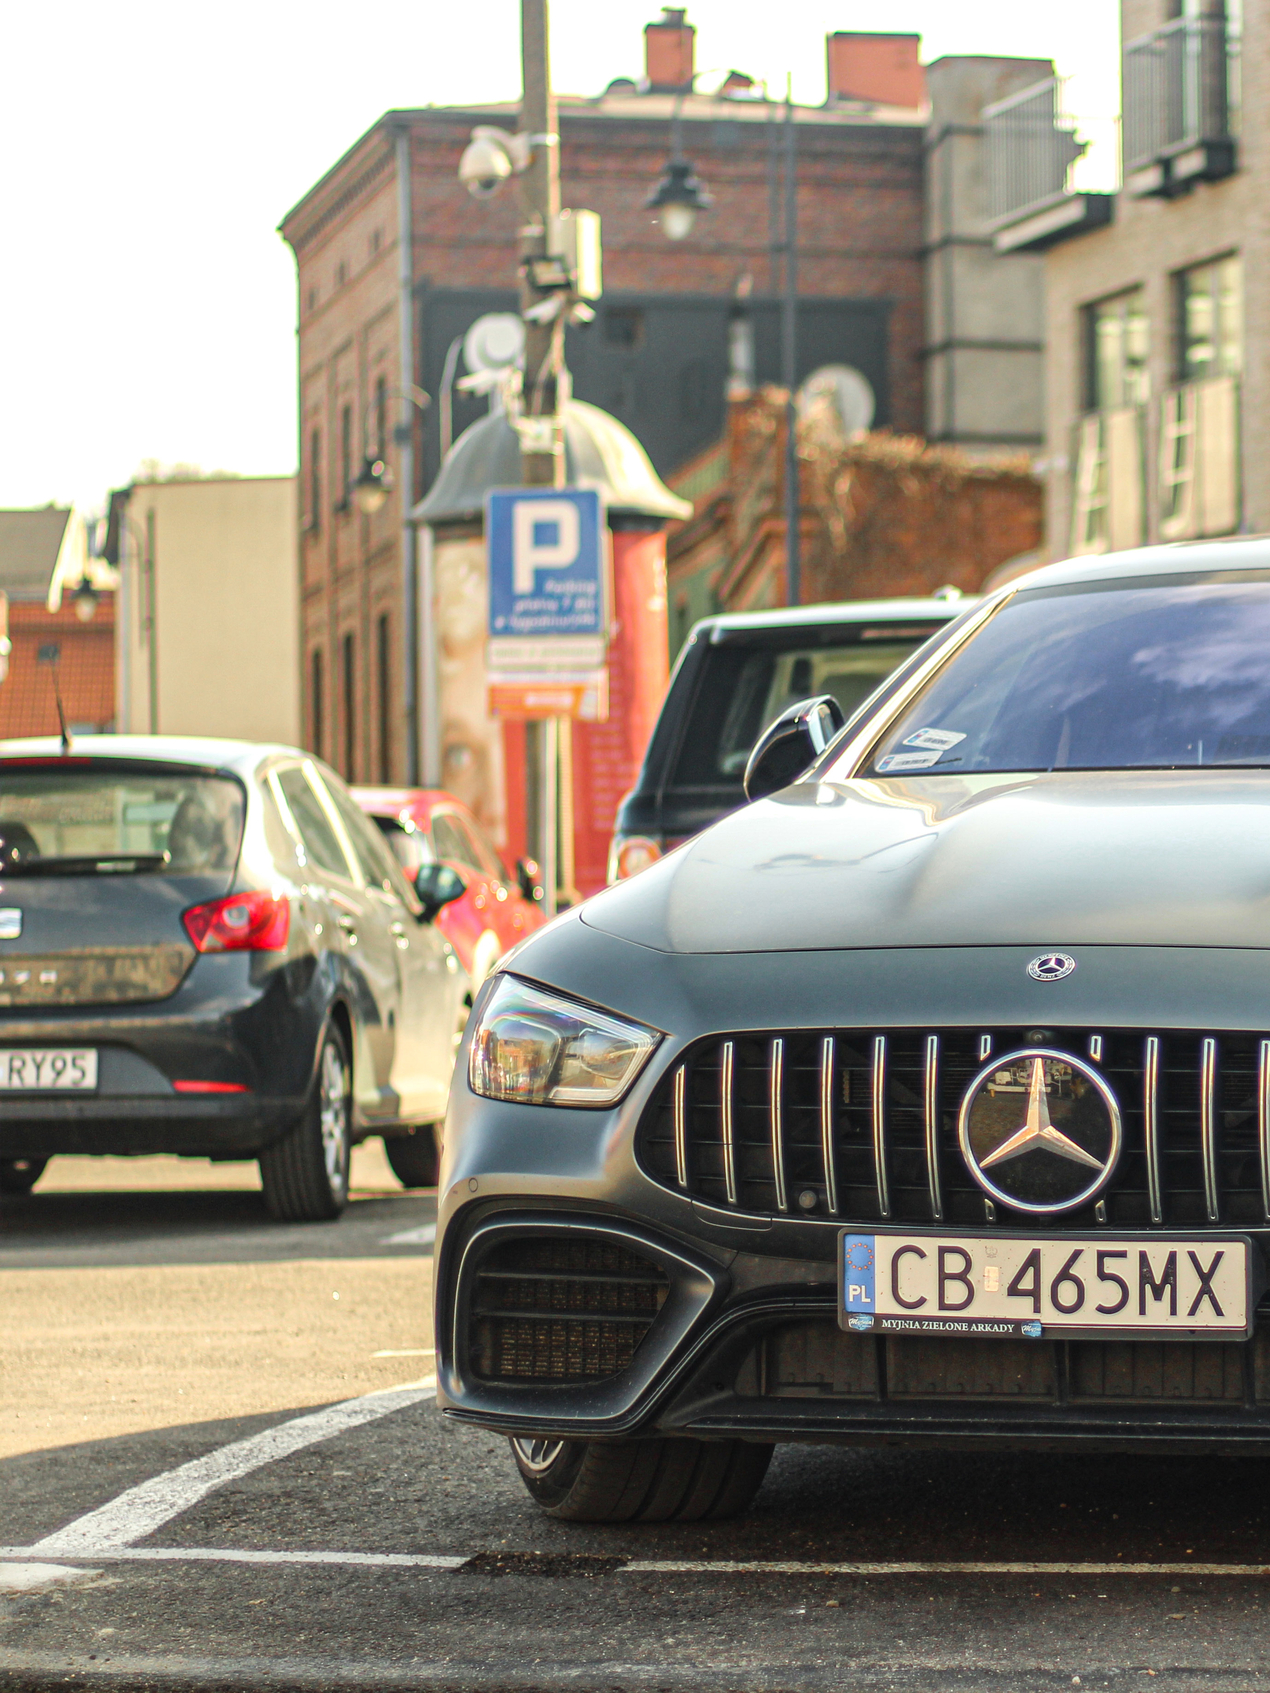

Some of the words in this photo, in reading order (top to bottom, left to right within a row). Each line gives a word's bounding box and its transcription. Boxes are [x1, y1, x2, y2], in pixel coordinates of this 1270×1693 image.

[512, 499, 580, 595] P
[8, 1052, 87, 1087] RY95
[848, 1284, 872, 1304] PL
[891, 1244, 976, 1311] CB
[1006, 1247, 1226, 1317] 465MX
[881, 1319, 921, 1331] MYJNIA
[922, 1321, 968, 1332] ZIELONE
[970, 1322, 1016, 1334] ARKADY
